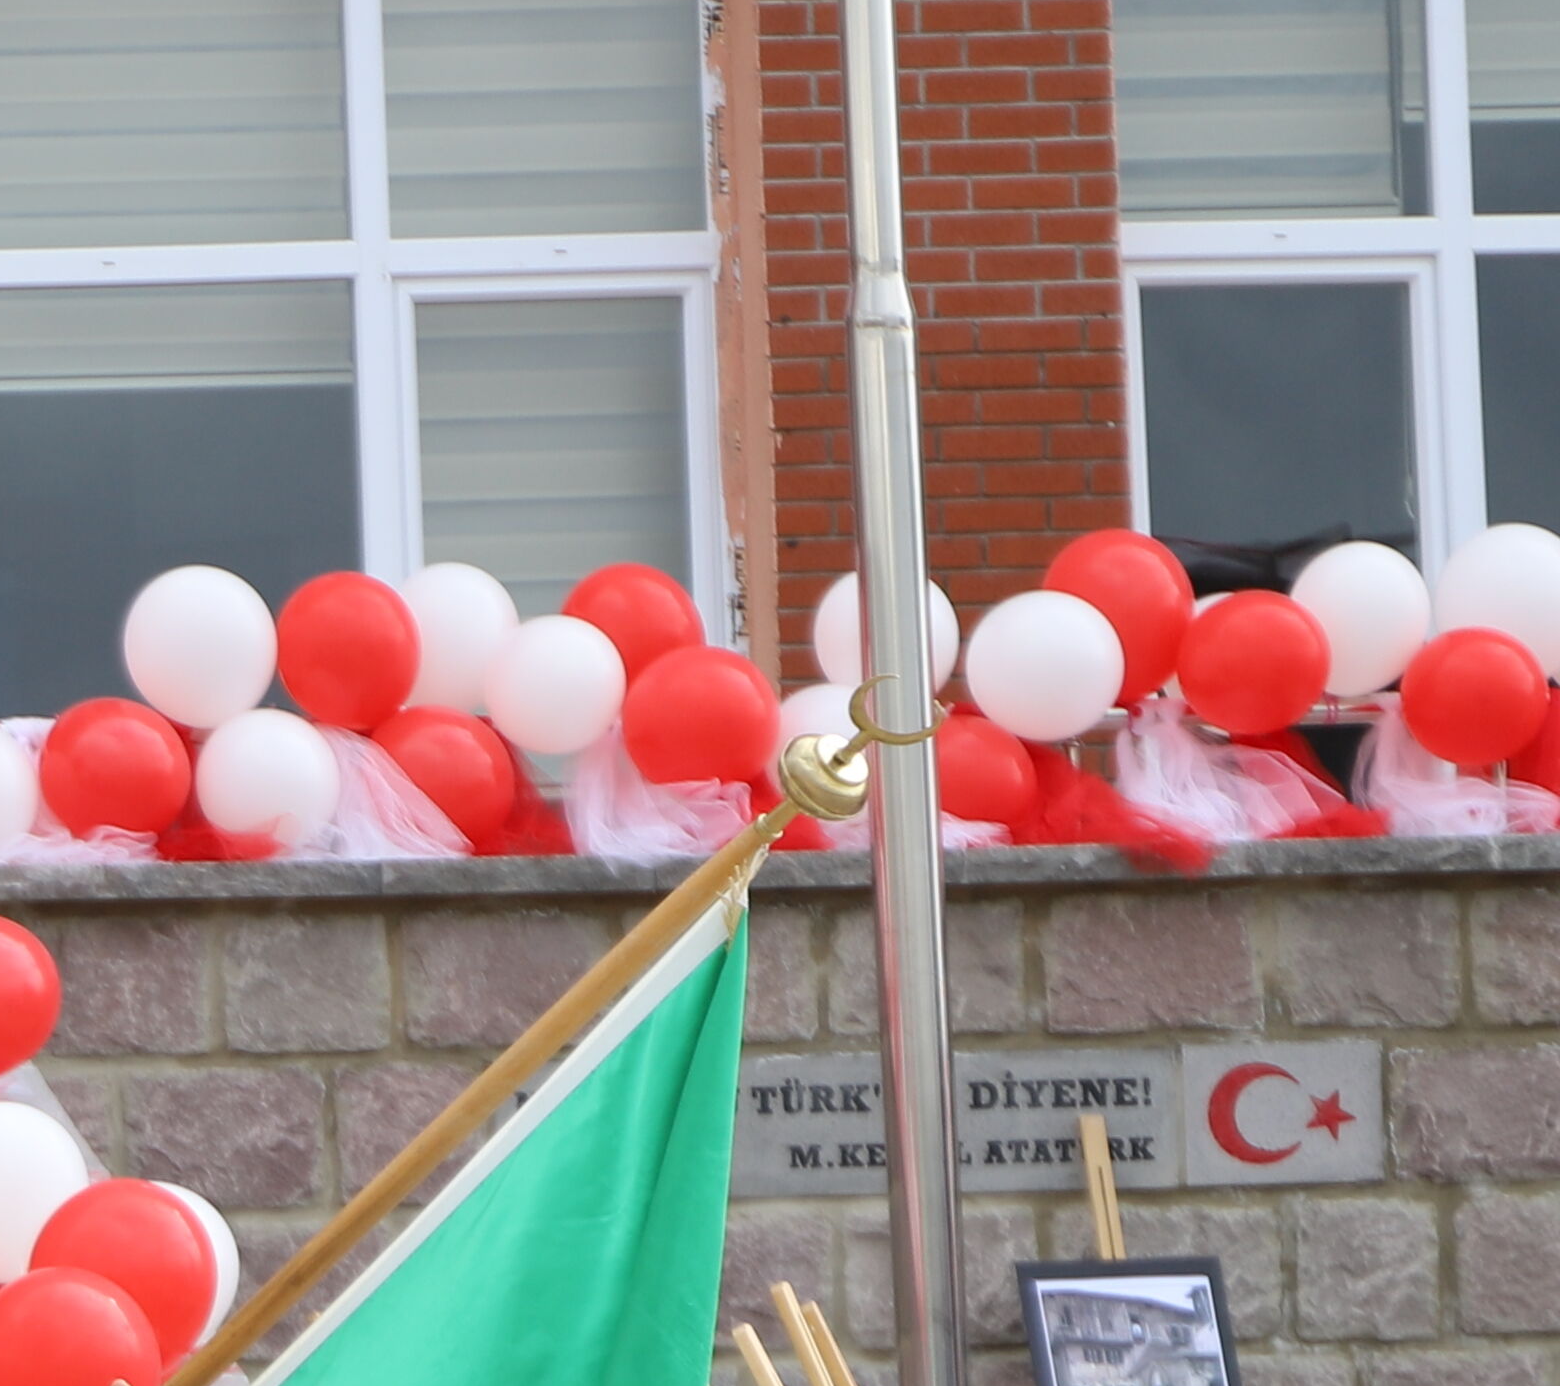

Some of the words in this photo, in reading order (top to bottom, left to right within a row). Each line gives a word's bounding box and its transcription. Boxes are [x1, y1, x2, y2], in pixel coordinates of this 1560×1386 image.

[751, 1077, 881, 1114] TÜRK'
[968, 1069, 1152, 1109] DİYENE!
[984, 1136, 1155, 1164] ATATRK
